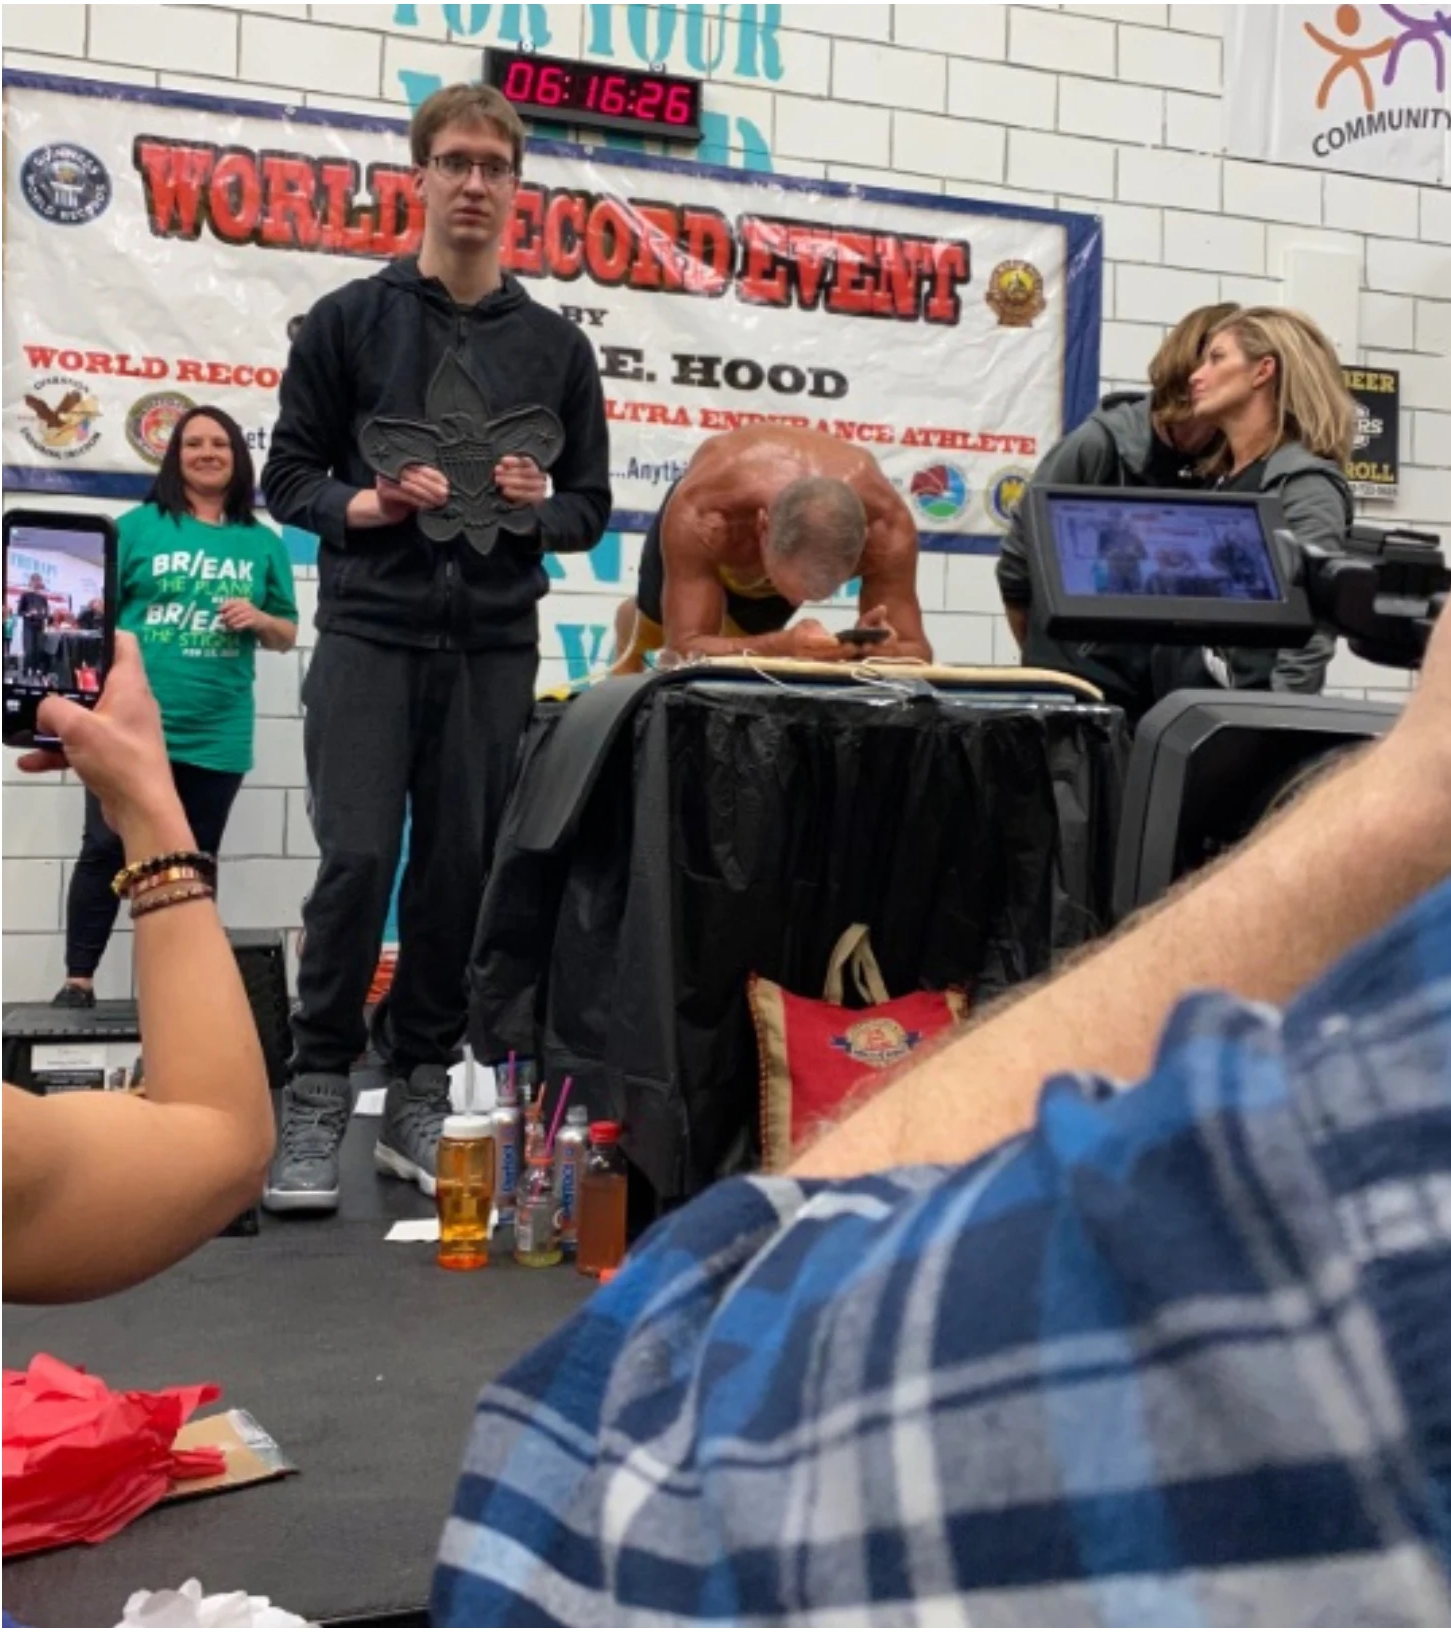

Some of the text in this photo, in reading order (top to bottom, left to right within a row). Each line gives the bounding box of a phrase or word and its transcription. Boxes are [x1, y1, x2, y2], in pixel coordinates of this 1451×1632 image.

[133, 134, 427, 259] WORLD
[500, 182, 738, 298] ECORD
[737, 213, 970, 326] EVENT
[560, 305, 608, 327] BY
[23, 345, 280, 388] WORLD RECO
[671, 354, 848, 400] HOOD
[605, 400, 692, 427] LTRA
[901, 426, 1037, 455] ATHLETE
[145, 600, 228, 631] BR/EA
